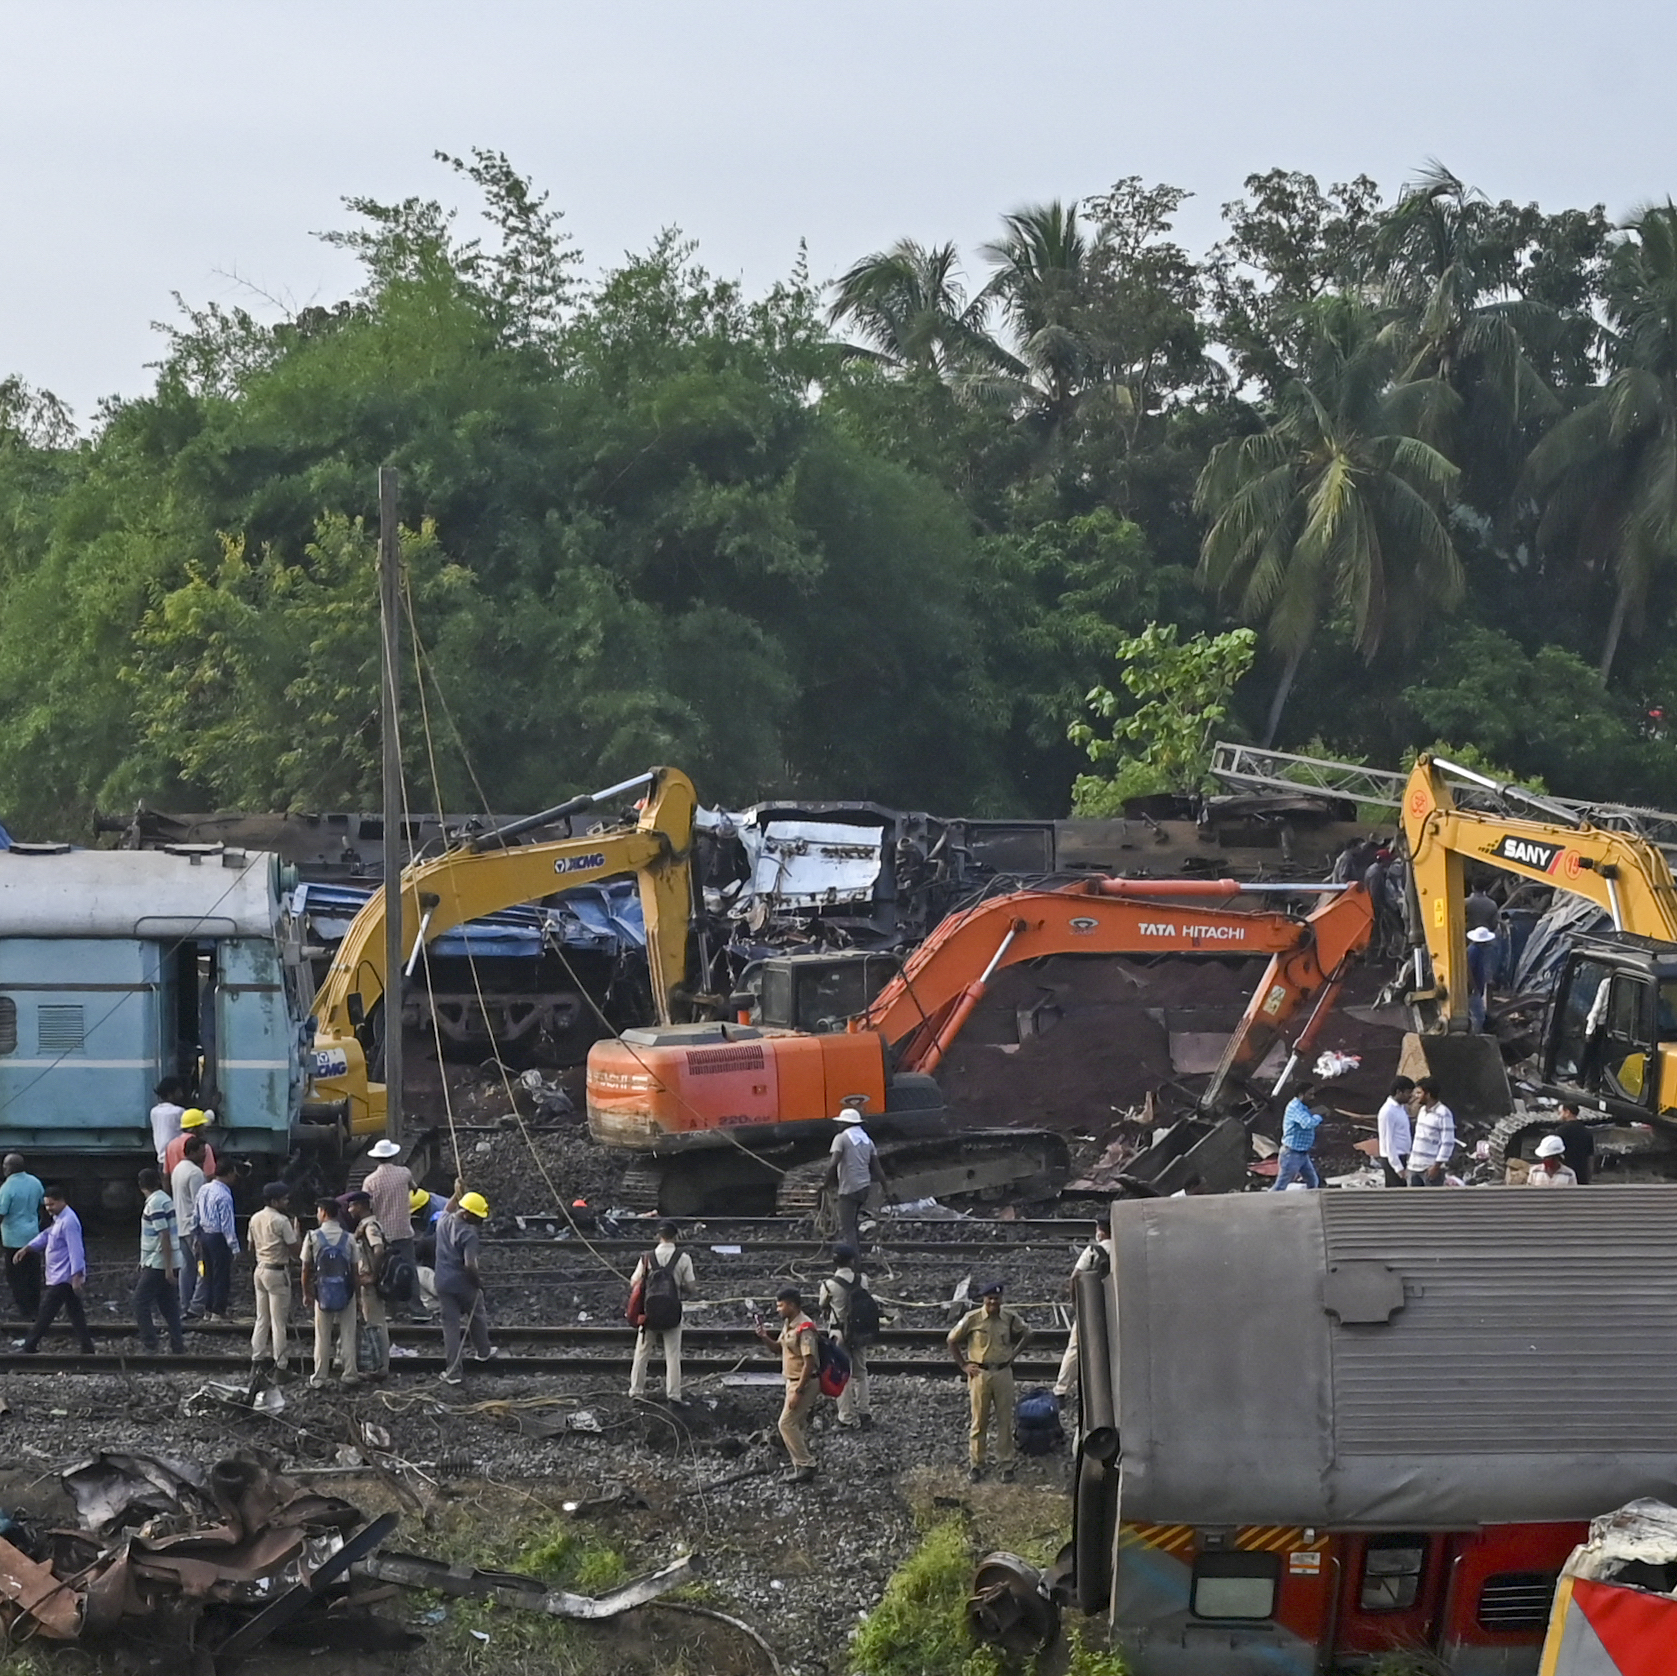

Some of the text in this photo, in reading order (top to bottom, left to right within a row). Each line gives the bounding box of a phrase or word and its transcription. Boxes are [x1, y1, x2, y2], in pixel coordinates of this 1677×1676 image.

[1504, 839, 1551, 866] SANY
[1138, 923, 1245, 940] TATA HITACHI
